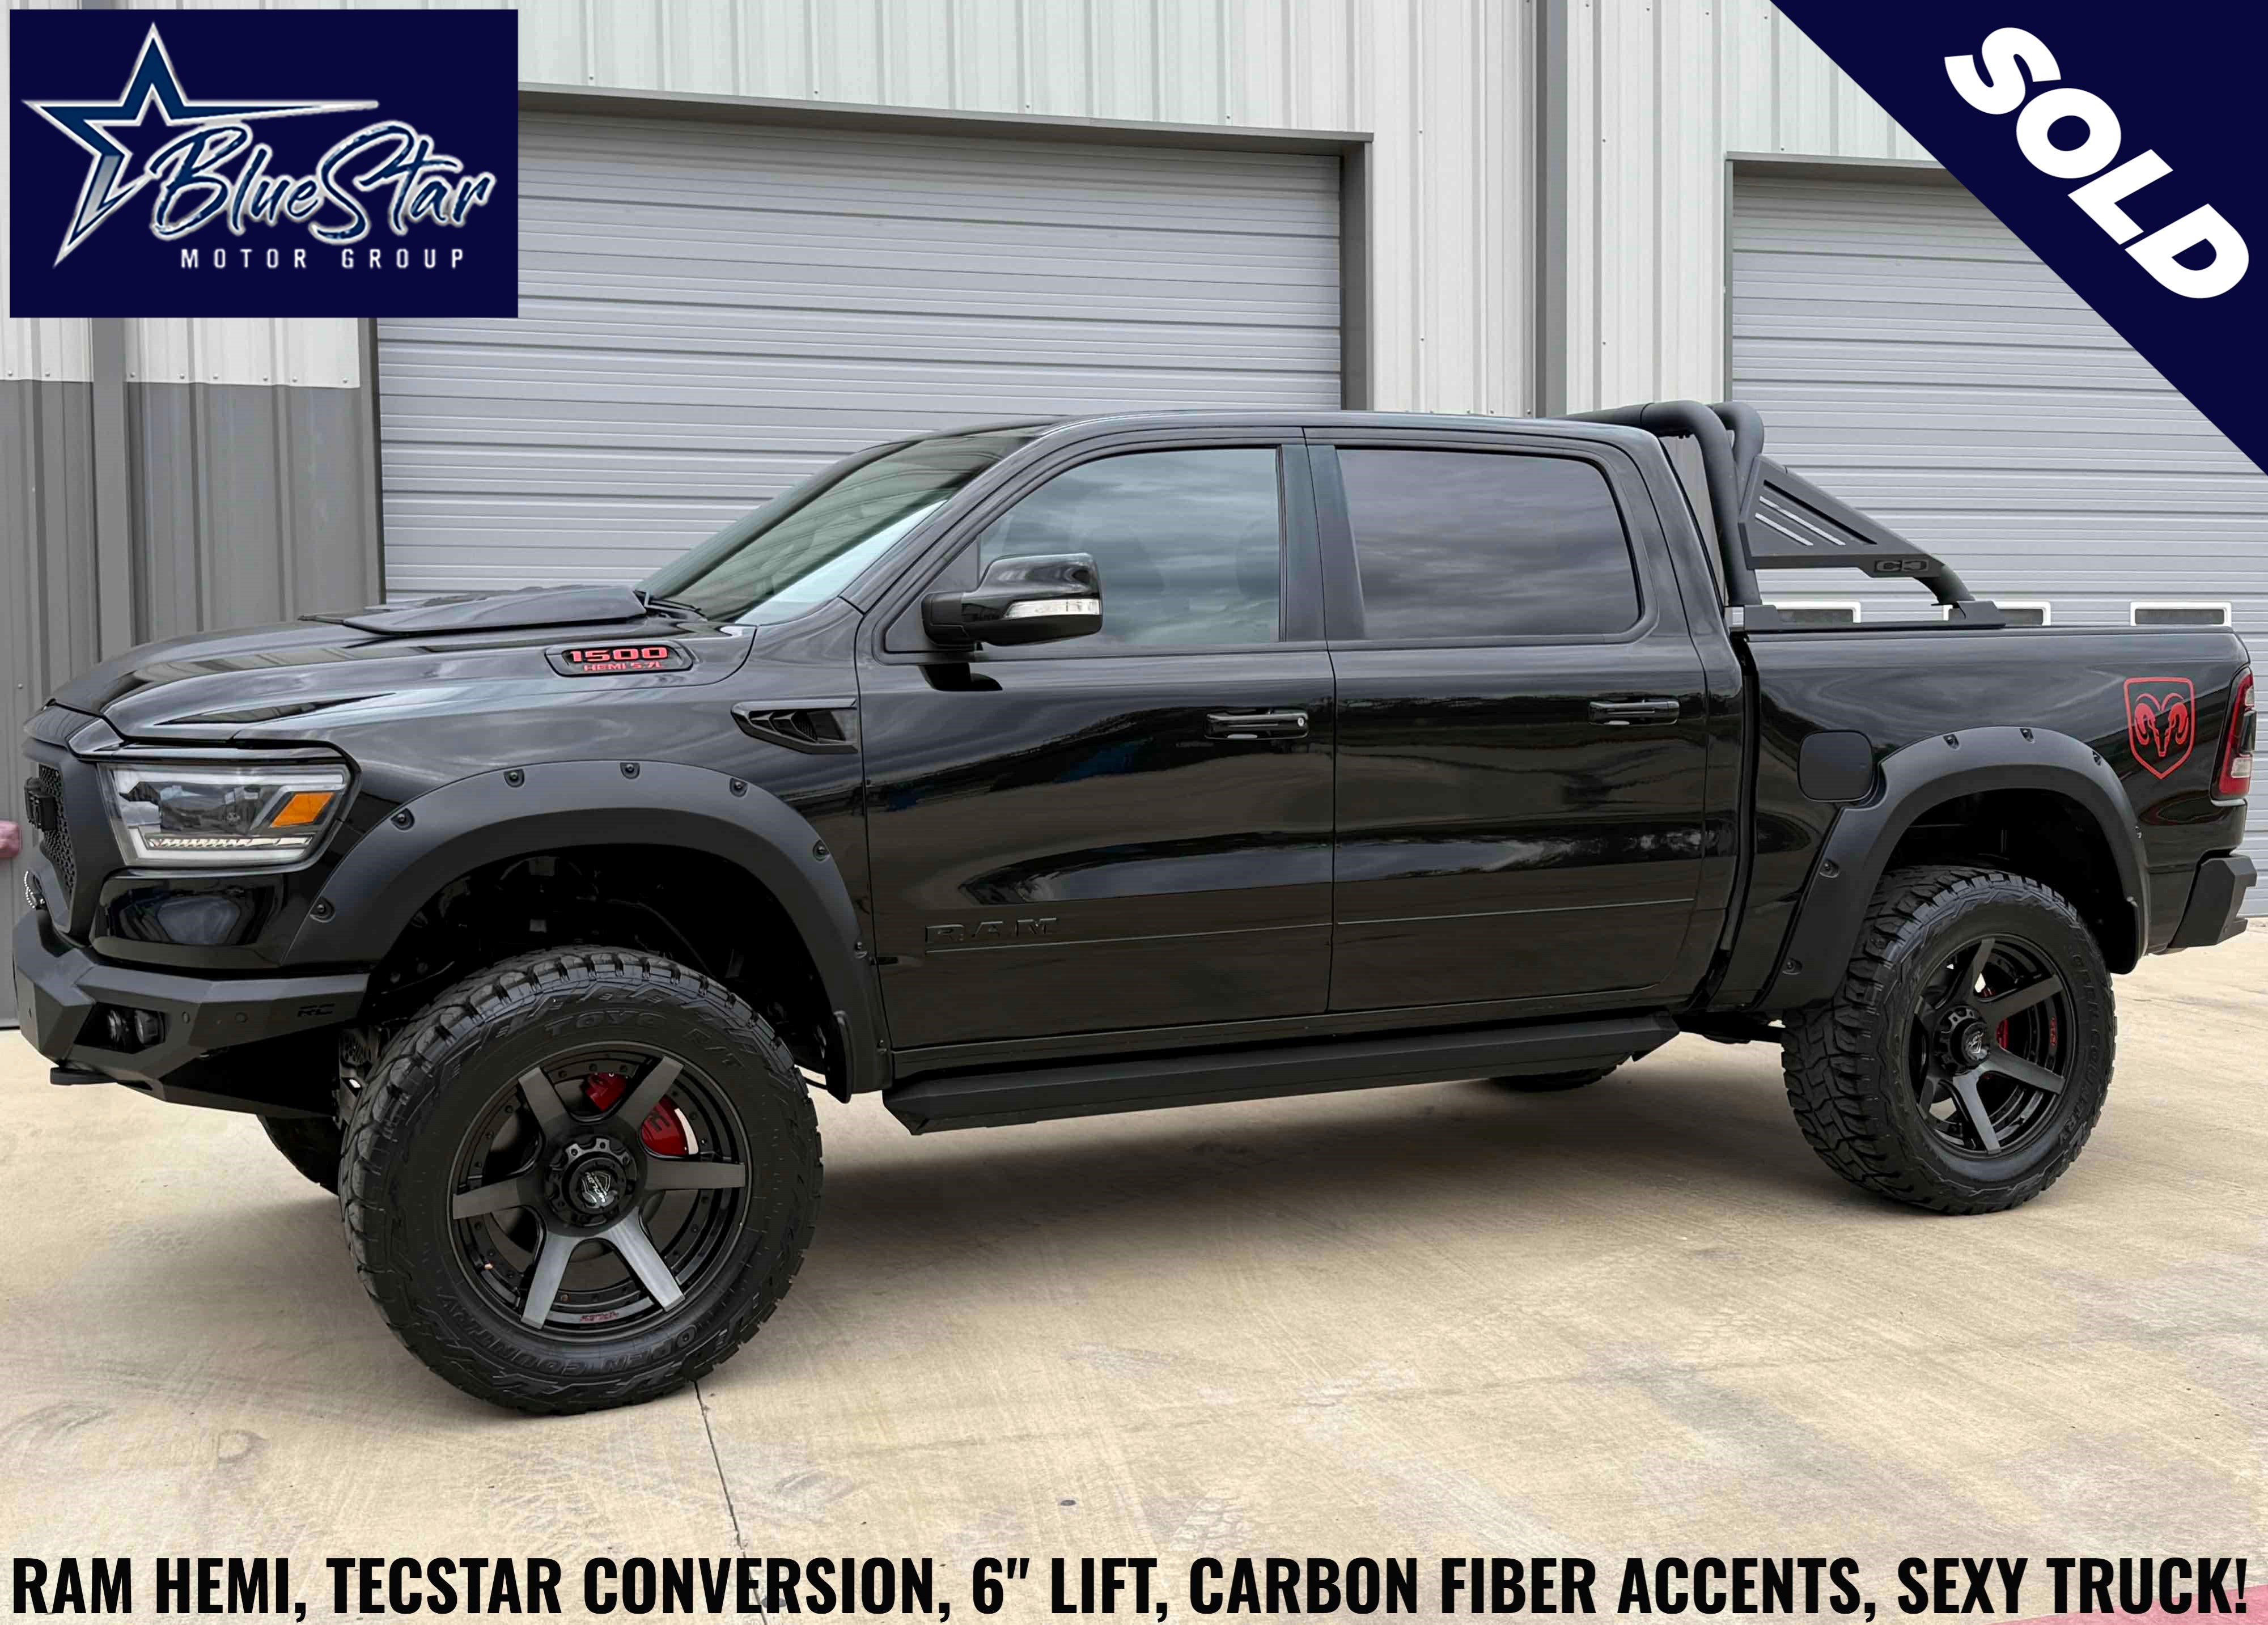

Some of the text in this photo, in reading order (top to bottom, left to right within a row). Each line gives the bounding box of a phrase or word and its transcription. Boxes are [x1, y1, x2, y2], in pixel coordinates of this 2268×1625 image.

[570, 647, 668, 663] 1500
[583, 663, 626, 672] HEMI
[925, 917, 1058, 942] RAM
[544, 1008, 667, 1037] TOYO
[602, 1322, 698, 1375] OPEN
